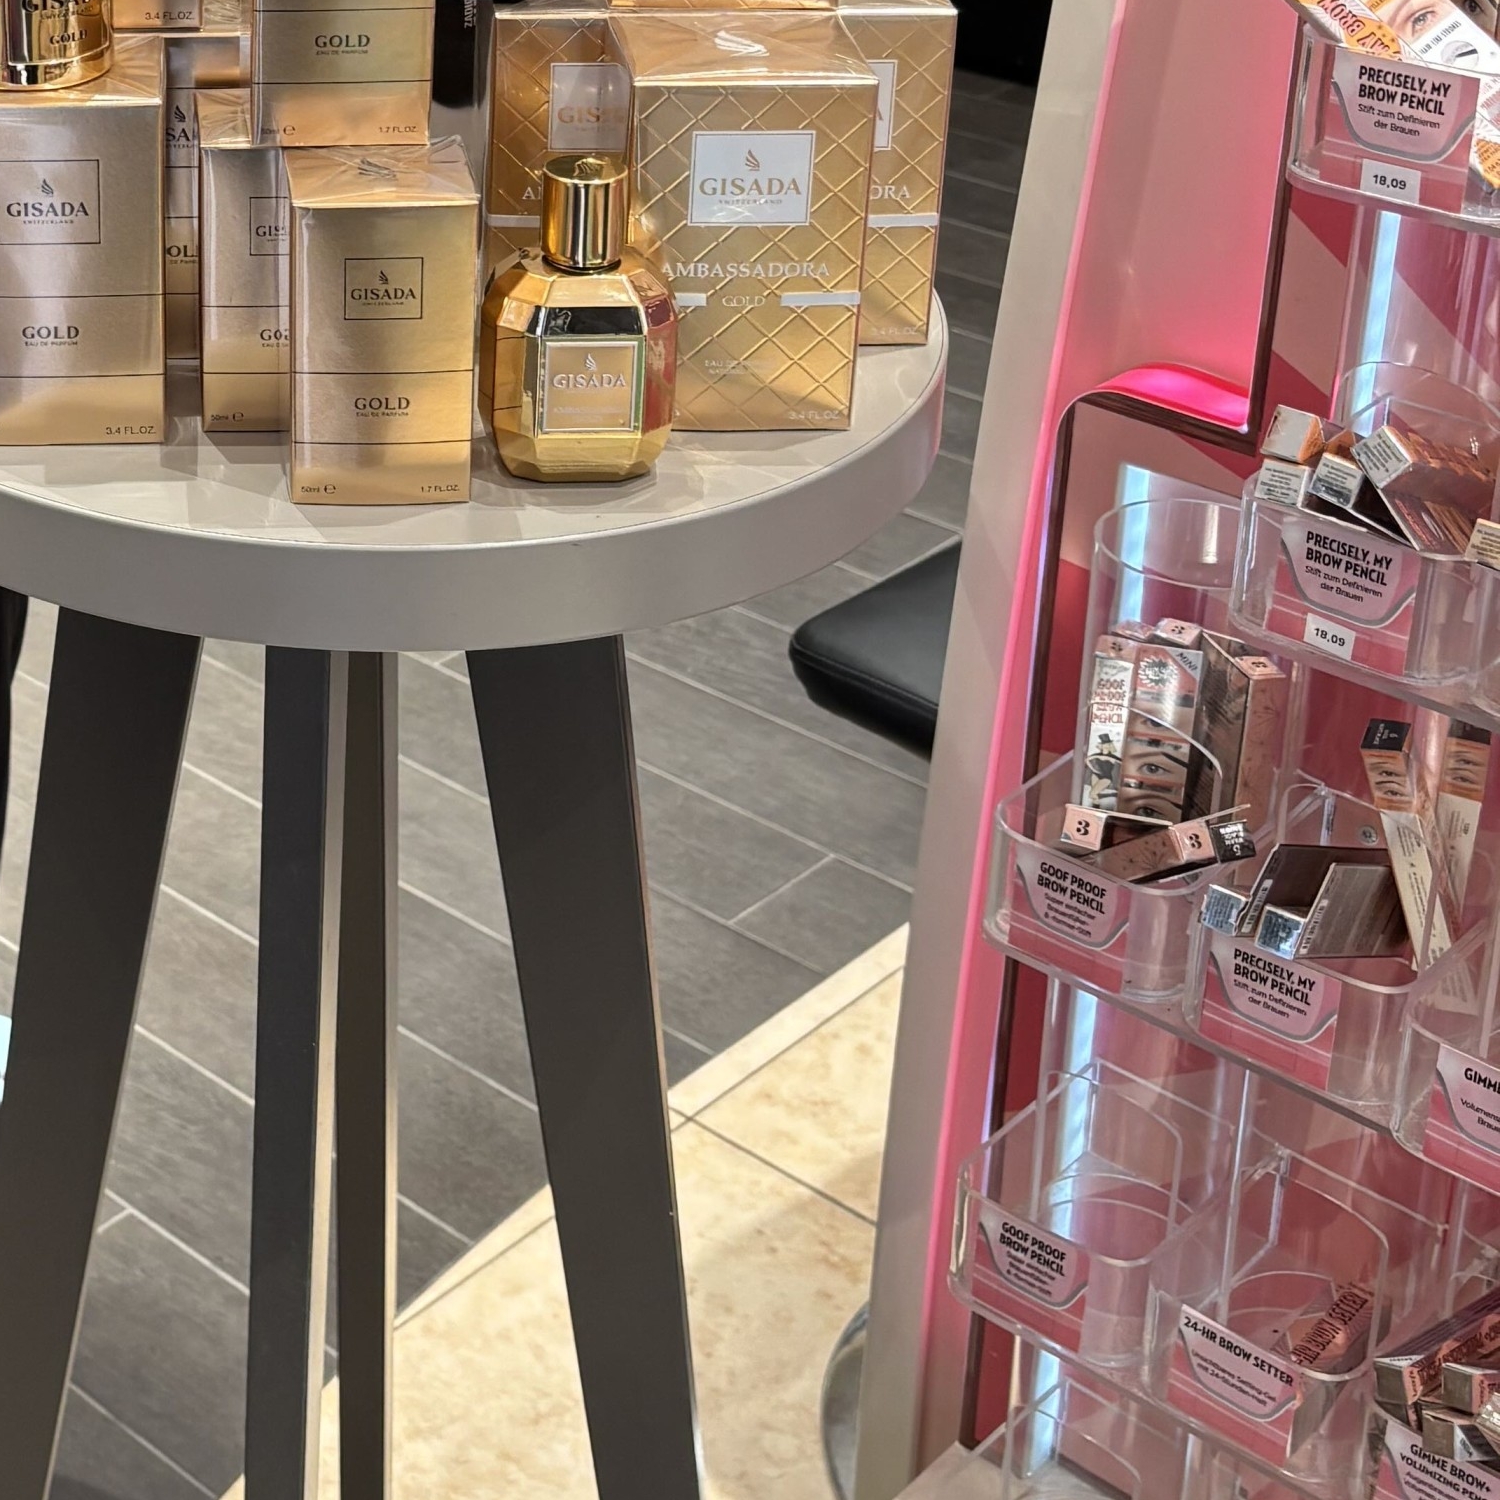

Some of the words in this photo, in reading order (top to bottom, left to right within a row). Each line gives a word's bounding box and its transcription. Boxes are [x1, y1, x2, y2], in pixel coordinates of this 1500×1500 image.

[49, 29, 88, 46] GOLD
[314, 34, 371, 49] GOLD
[1358, 65, 1428, 96] PRECISELY,
[1430, 82, 1452, 98] MY
[1357, 84, 1397, 106] BROW
[1399, 94, 1445, 116] PENCIL
[1358, 103, 1376, 115] Stift
[1377, 109, 1395, 119] zum
[1396, 112, 1441, 129] Definieren
[1374, 119, 1388, 129] der
[1389, 123, 1420, 137] Brauen
[699, 177, 802, 197] GISADA
[6, 201, 89, 218] GISADA
[662, 261, 830, 279] AMBASSADORA
[350, 288, 417, 301] GISADA
[722, 294, 766, 308] GOLD
[21, 325, 80, 340] GOLD
[552, 372, 628, 389] GISADA
[354, 396, 411, 411] GOLD
[105, 426, 122, 436] 3.4
[1305, 531, 1371, 564] PRECISELY,
[1374, 554, 1393, 571] MY
[1305, 547, 1342, 571] BROW
[1344, 559, 1388, 586] PENCIL
[1305, 565, 1322, 578] Stift
[1323, 573, 1341, 584] zum
[1342, 575, 1383, 598] Definieren
[1320, 581, 1335, 593] der
[1335, 586, 1364, 603] Brauen
[1175, 651, 1199, 671] MINI
[1075, 819, 1091, 836] 3
[1040, 861, 1069, 884] GOOF
[1070, 874, 1107, 899] PROOF
[1037, 874, 1068, 898] BROW
[1069, 888, 1106, 915] PENCIL
[1234, 948, 1296, 984] PRECISELY,
[1297, 974, 1316, 991] MY
[1233, 962, 1269, 988] BROW
[1271, 978, 1311, 1006] PENCIL
[1001, 1221, 1030, 1245] GOOF
[1031, 1237, 1066, 1262] PROOF
[999, 1233, 1029, 1259] BROW
[1030, 1249, 1065, 1277] PENCIL
[1183, 1316, 1217, 1343] 24-HR
[1219, 1336, 1253, 1362] BROW
[1251, 1356, 1294, 1387] SETTER
[1400, 1453, 1460, 1492] VOLUMIZING
[1410, 1444, 1449, 1472] GIMME
[1449, 1463, 1492, 1493] BROW+
